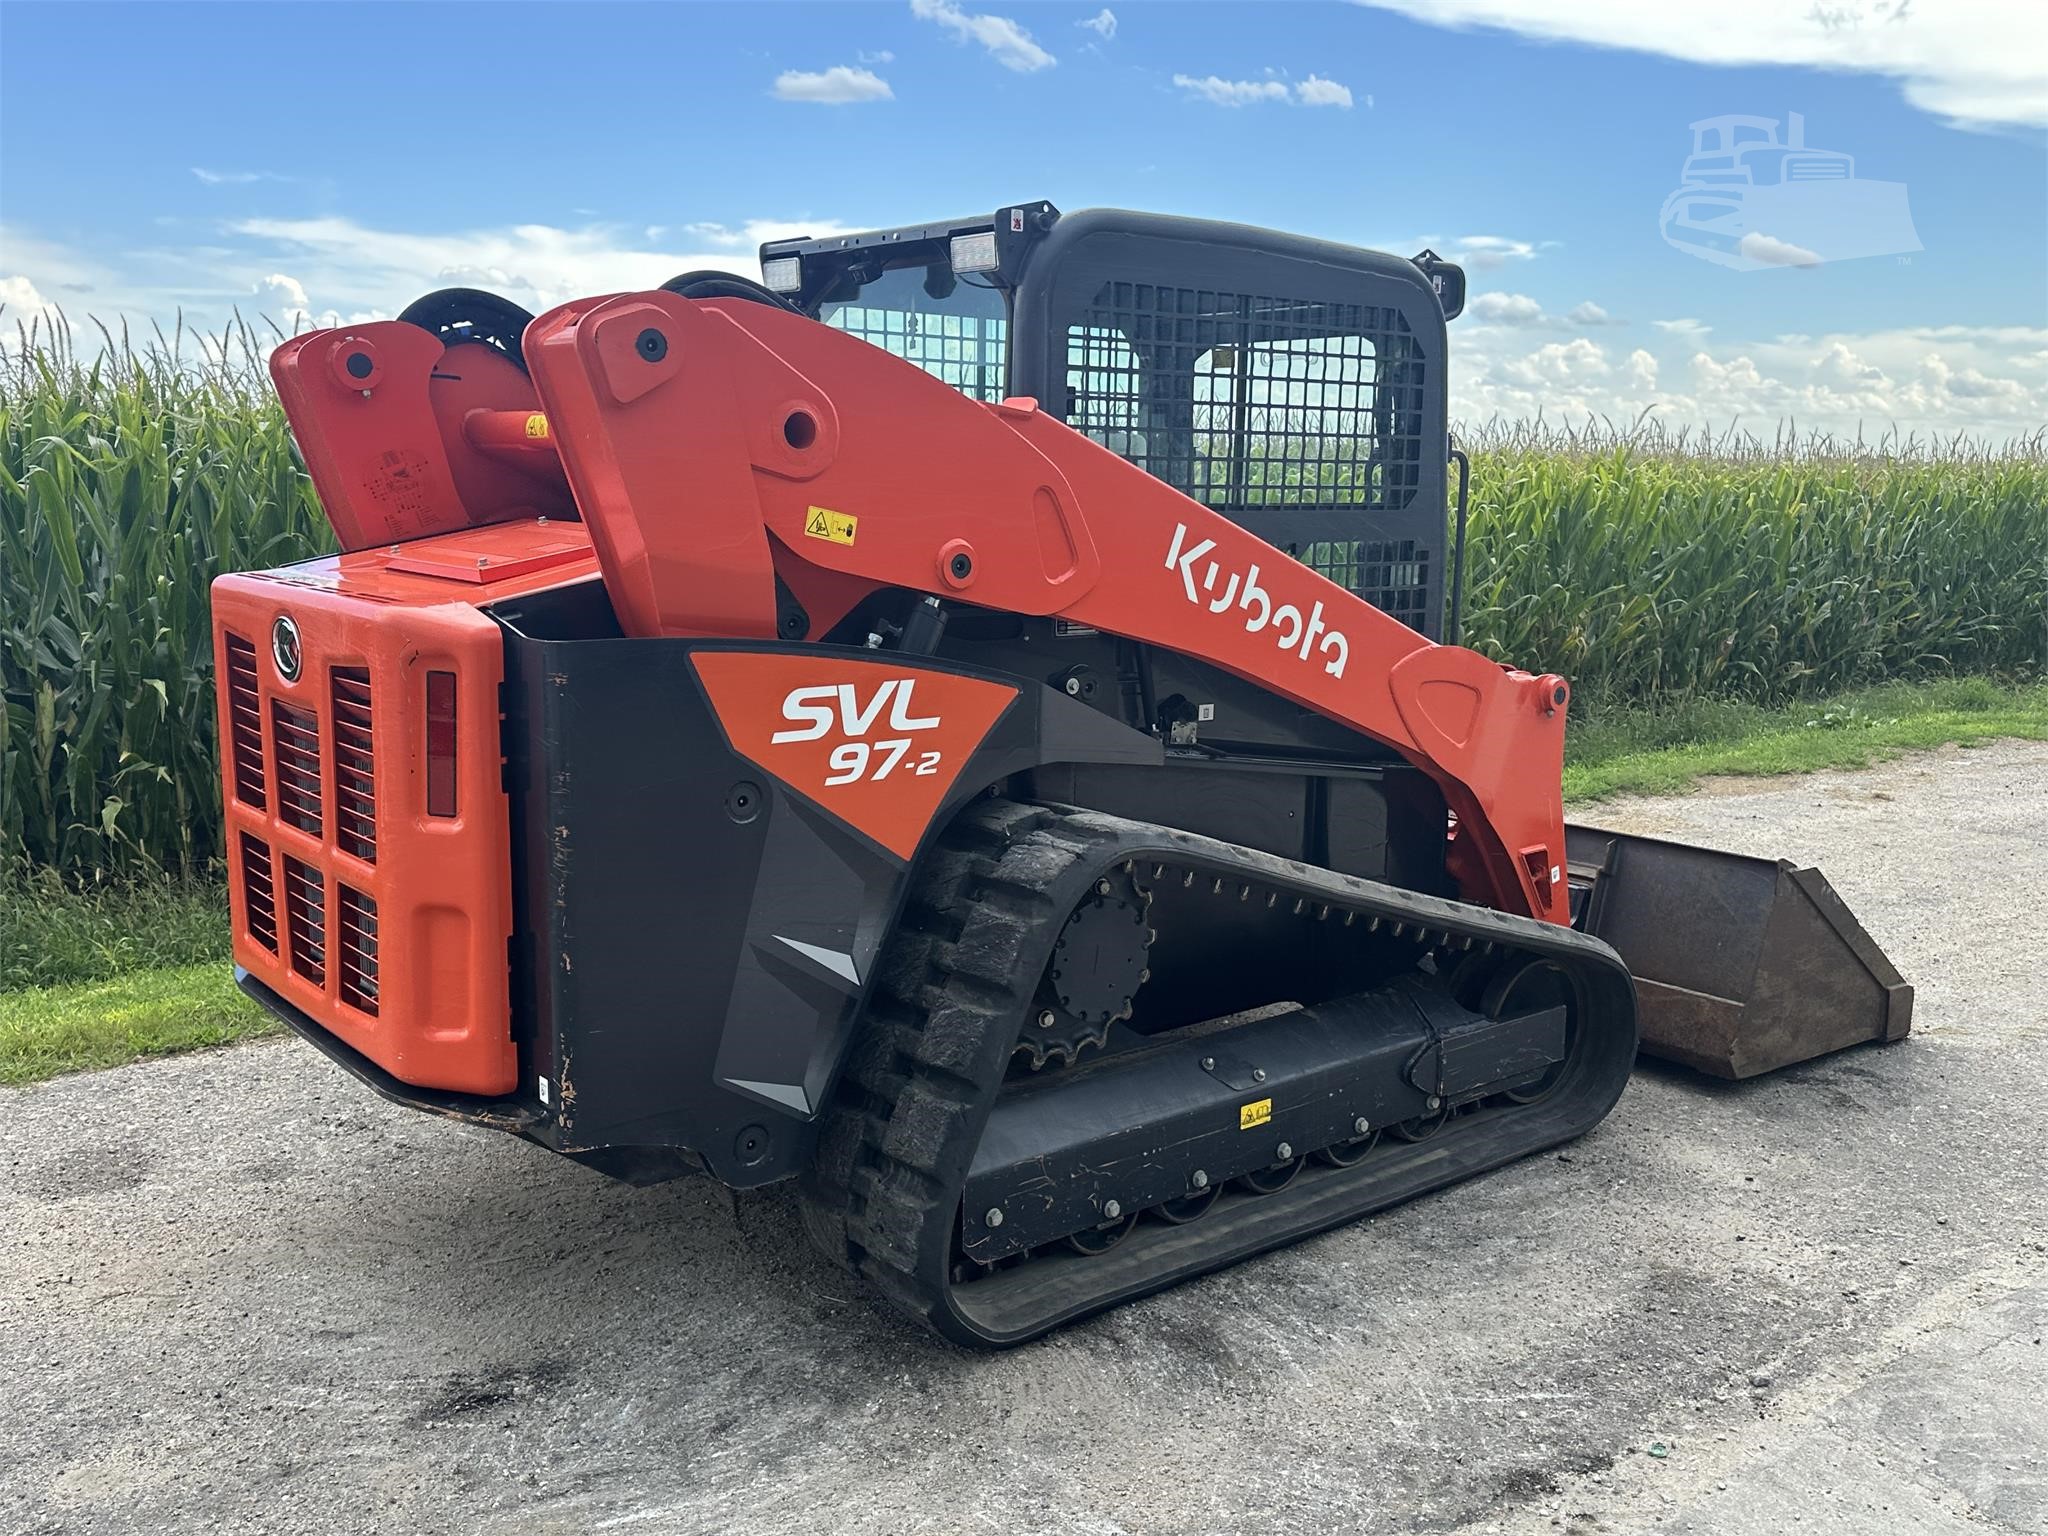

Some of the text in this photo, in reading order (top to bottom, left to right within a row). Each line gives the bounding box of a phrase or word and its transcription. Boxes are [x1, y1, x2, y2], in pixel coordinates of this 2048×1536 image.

[1164, 522, 1349, 680] Kubota
[771, 678, 941, 745] SVL
[824, 738, 942, 787] 97-2
